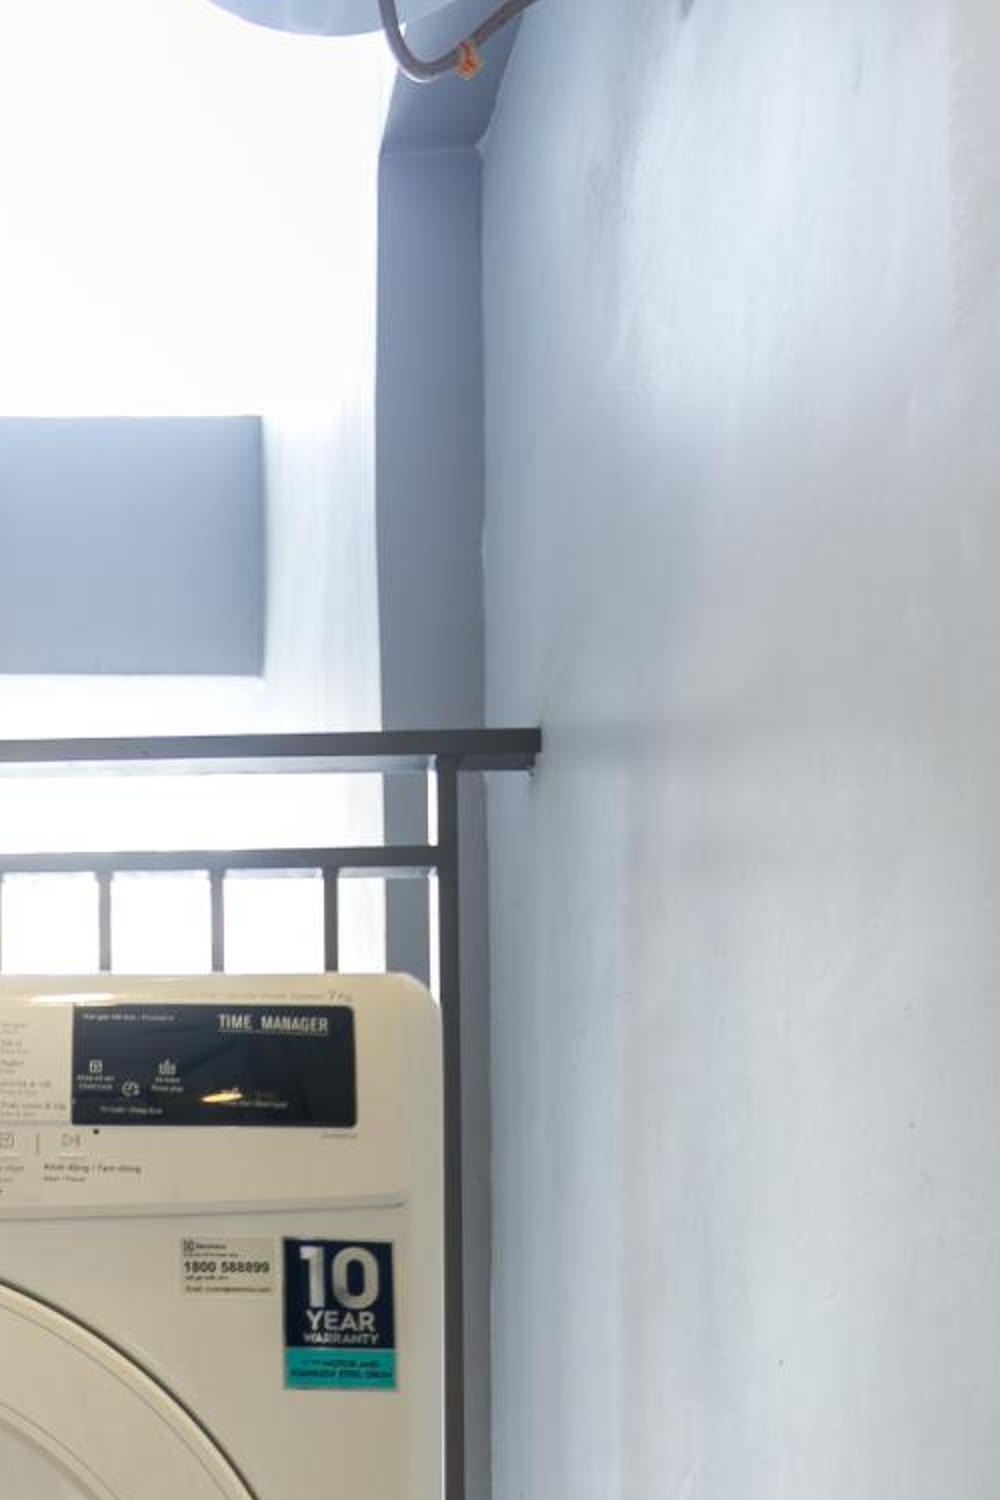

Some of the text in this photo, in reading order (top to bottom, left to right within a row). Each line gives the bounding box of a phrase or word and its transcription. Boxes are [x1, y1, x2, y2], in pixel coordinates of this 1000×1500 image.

[218, 1013, 329, 1032] TIME MANAGER
[183, 1261, 218, 1274] 1800
[299, 1245, 380, 1310] 10
[305, 1309, 376, 1333] YEAR
[303, 1332, 380, 1345] WARRANTY
